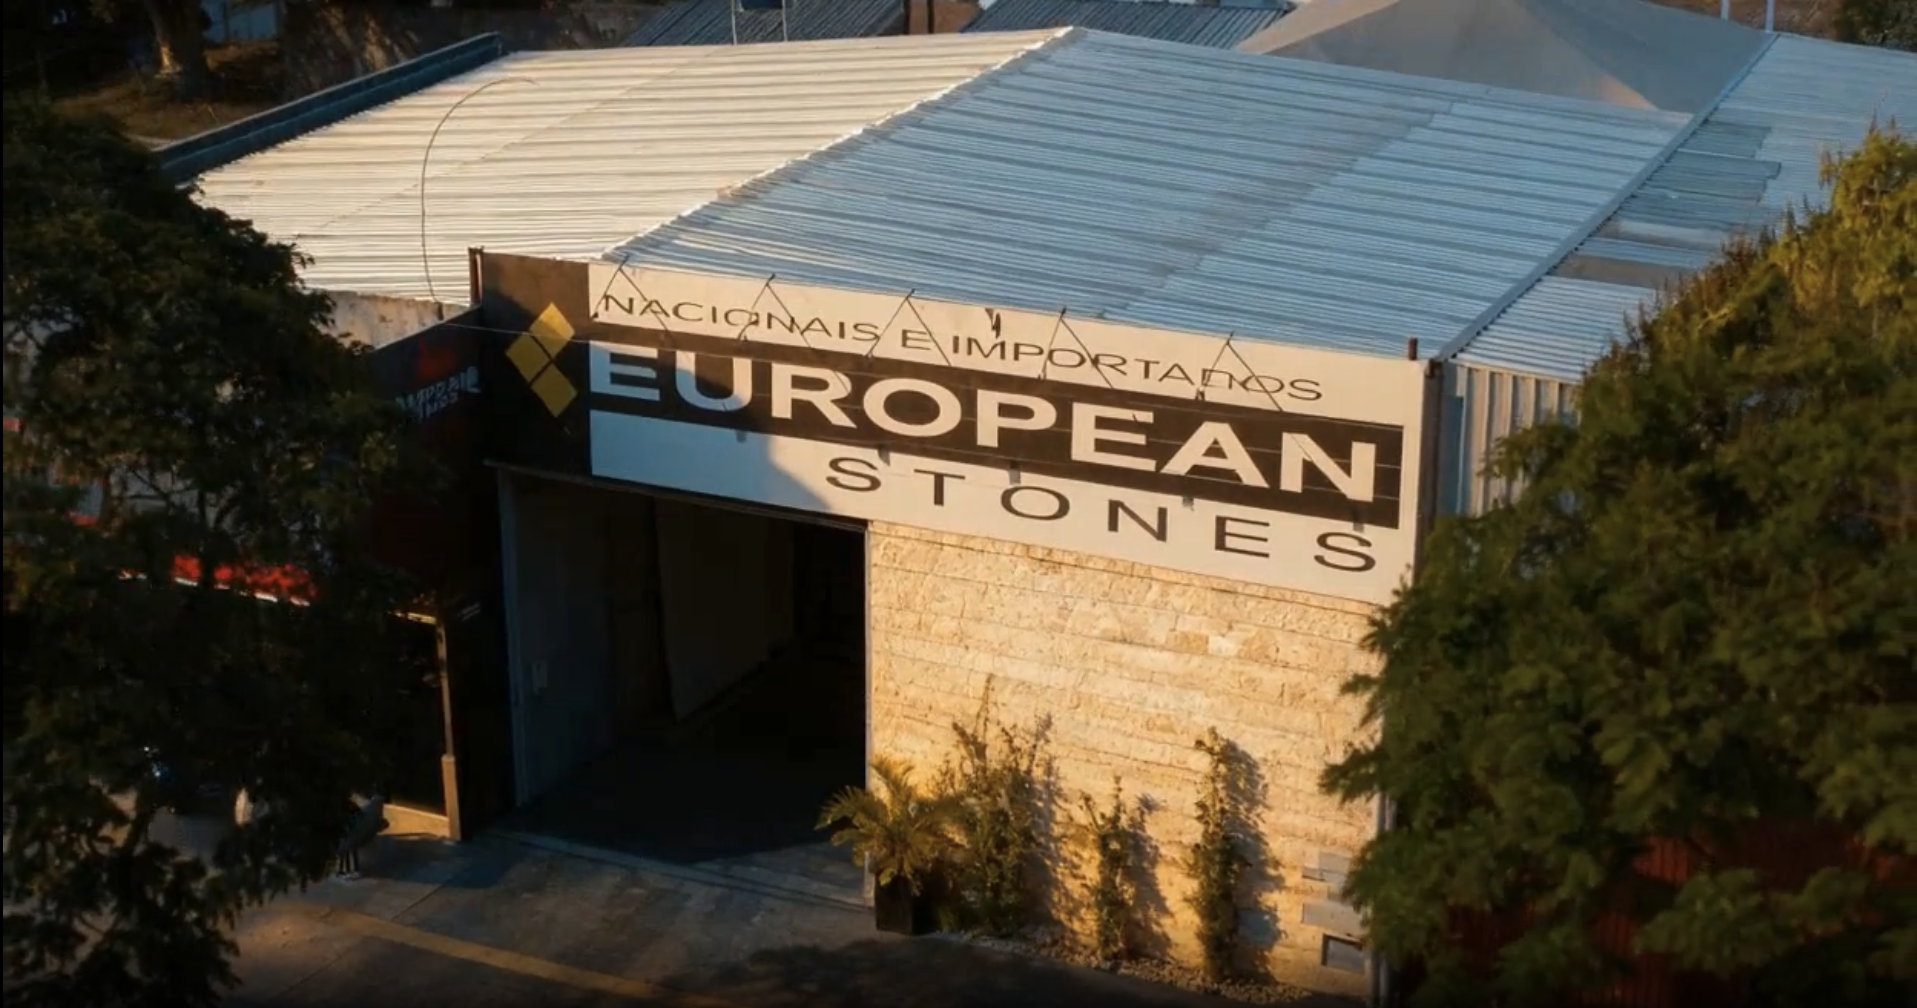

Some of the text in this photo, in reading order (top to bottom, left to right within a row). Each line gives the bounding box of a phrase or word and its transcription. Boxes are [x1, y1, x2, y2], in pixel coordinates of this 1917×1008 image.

[604, 295, 1323, 401] NACIONAIS E IMPORTADOS
[589, 340, 1377, 503] EUROPEAN
[826, 457, 1376, 573] STONES
